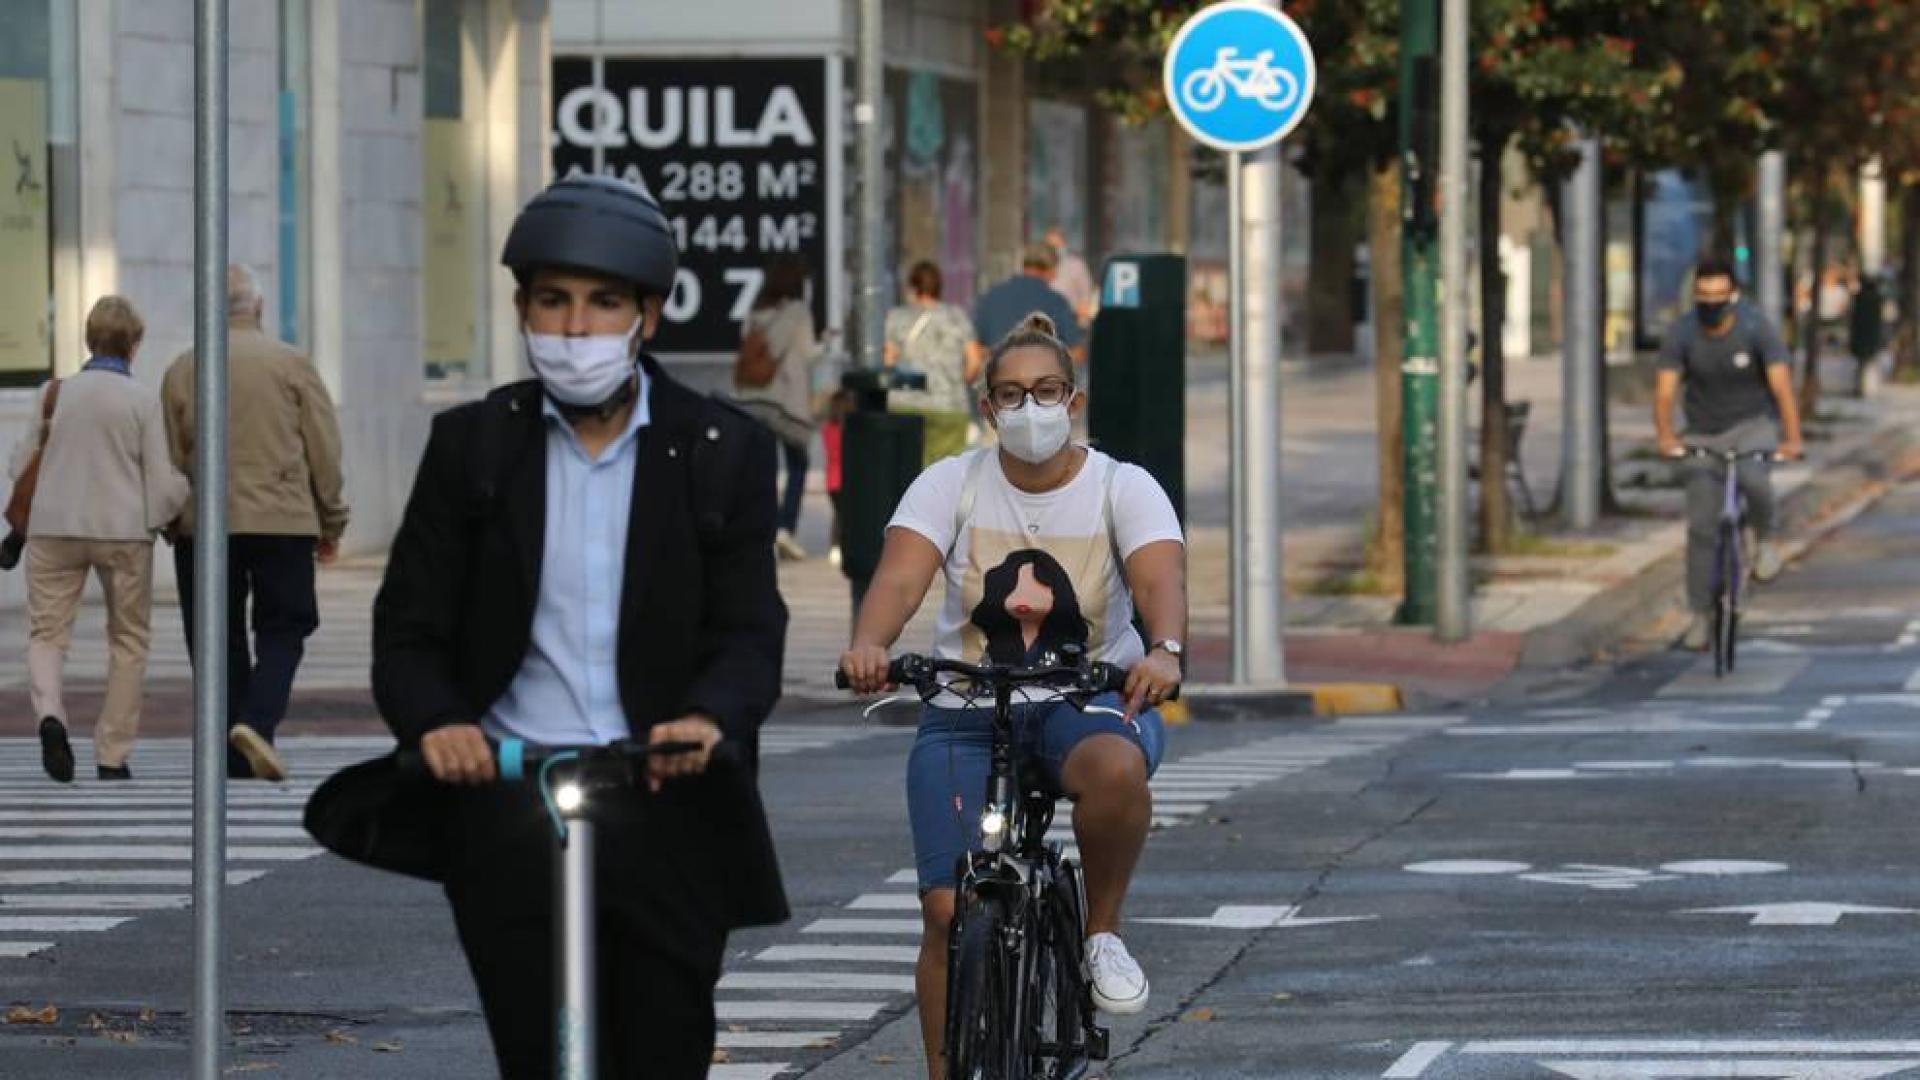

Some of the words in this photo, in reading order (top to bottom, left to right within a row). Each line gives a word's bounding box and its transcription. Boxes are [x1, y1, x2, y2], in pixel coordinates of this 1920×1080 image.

[551, 86, 815, 148] QUILA
[661, 161, 745, 200] 288
[671, 215, 748, 251] 144
[1112, 262, 1139, 304] P
